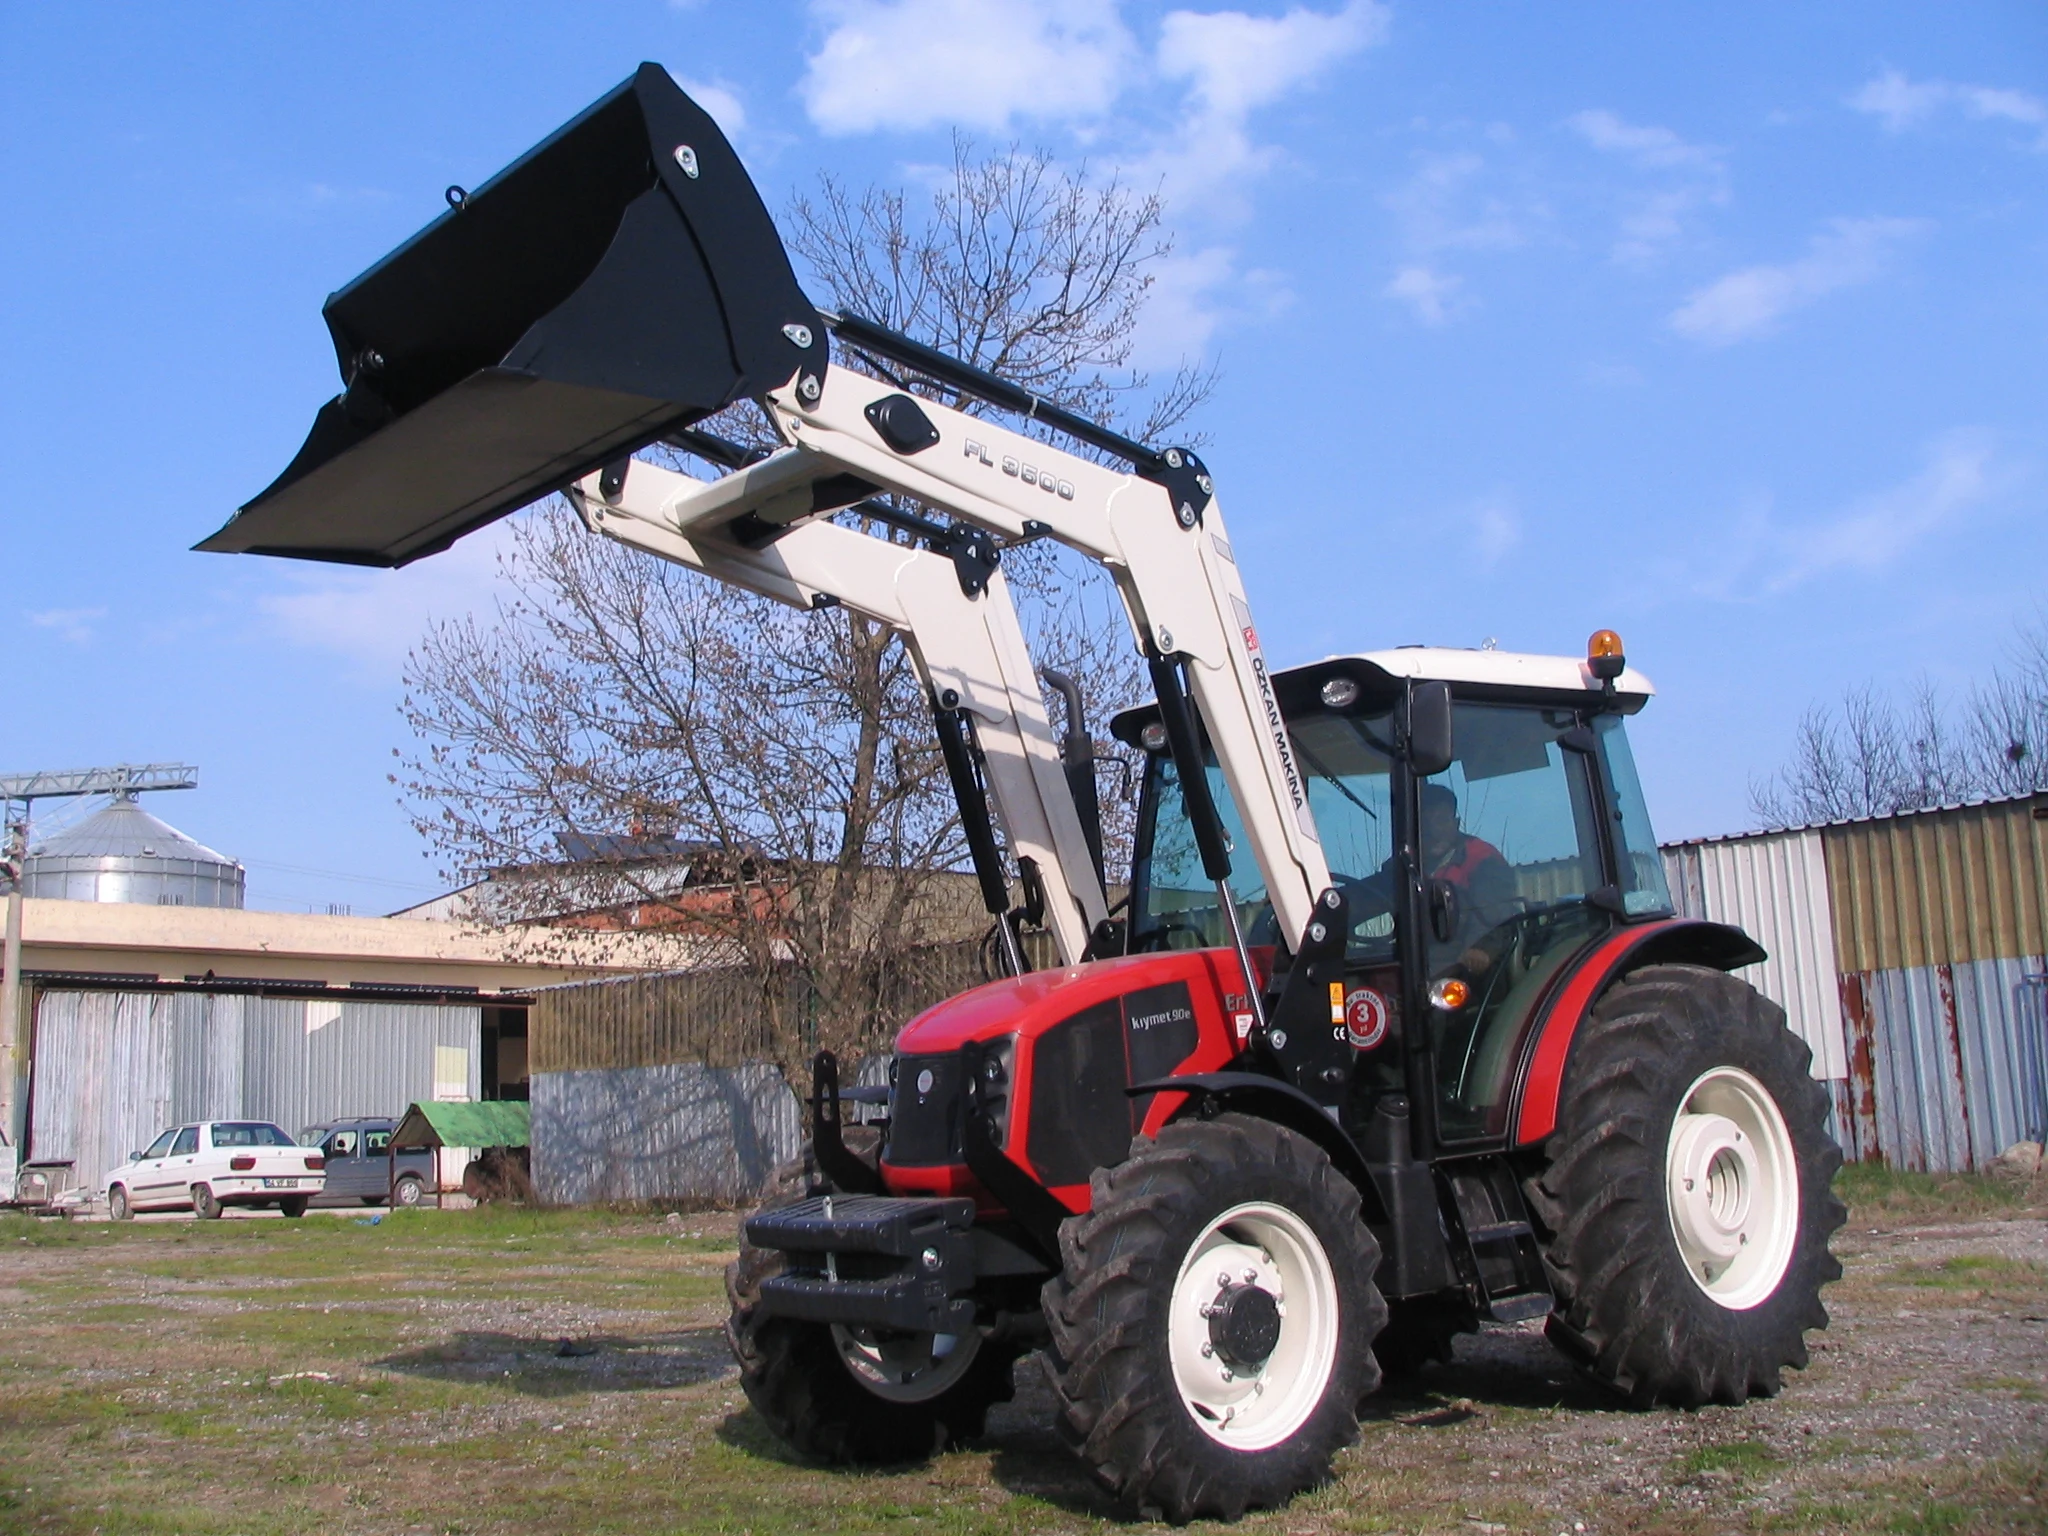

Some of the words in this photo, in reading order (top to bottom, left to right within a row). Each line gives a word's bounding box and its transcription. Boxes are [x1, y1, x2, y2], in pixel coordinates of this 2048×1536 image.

[964, 438, 994, 468] FL
[1002, 455, 1075, 501] 3500
[1253, 657, 1279, 726] ÖZKAN
[1333, 1026, 1346, 1041] CE
[1356, 1003, 1370, 1023] 3
